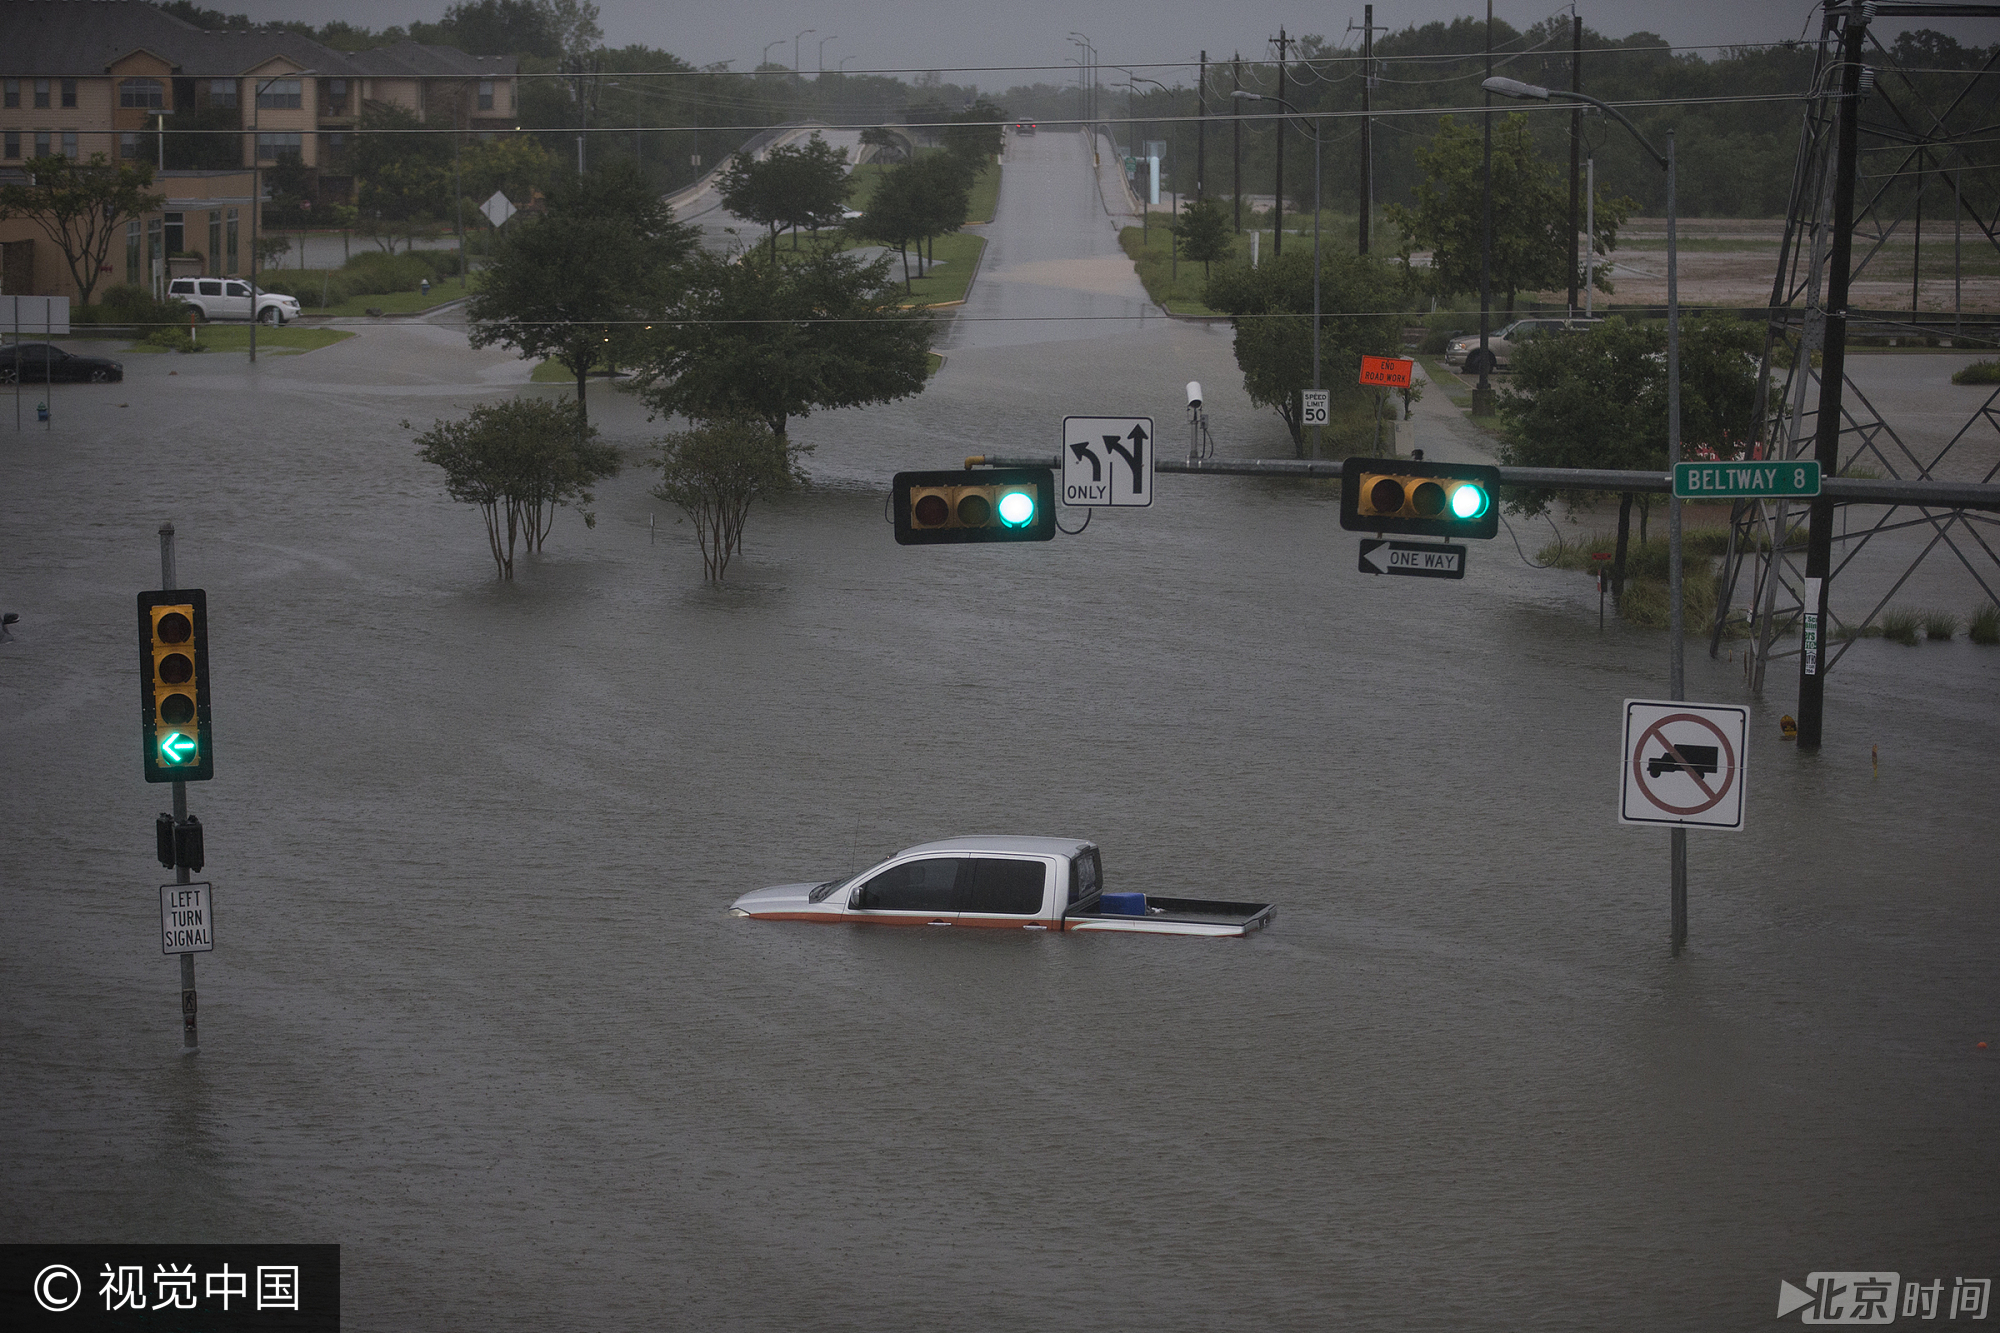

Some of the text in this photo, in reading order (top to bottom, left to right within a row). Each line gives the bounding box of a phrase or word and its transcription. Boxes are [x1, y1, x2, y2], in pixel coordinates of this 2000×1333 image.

[1381, 361, 1395, 370] END
[1365, 372, 1406, 383] ROAD WORK
[1305, 408, 1326, 421] 50
[1688, 468, 1806, 490] BELTWAY 8
[1067, 485, 1107, 499] ONLY
[1390, 551, 1455, 569] ONE WAY
[171, 890, 201, 908] LEFT
[171, 910, 203, 927] TURN
[165, 928, 211, 947] SIGNAL
